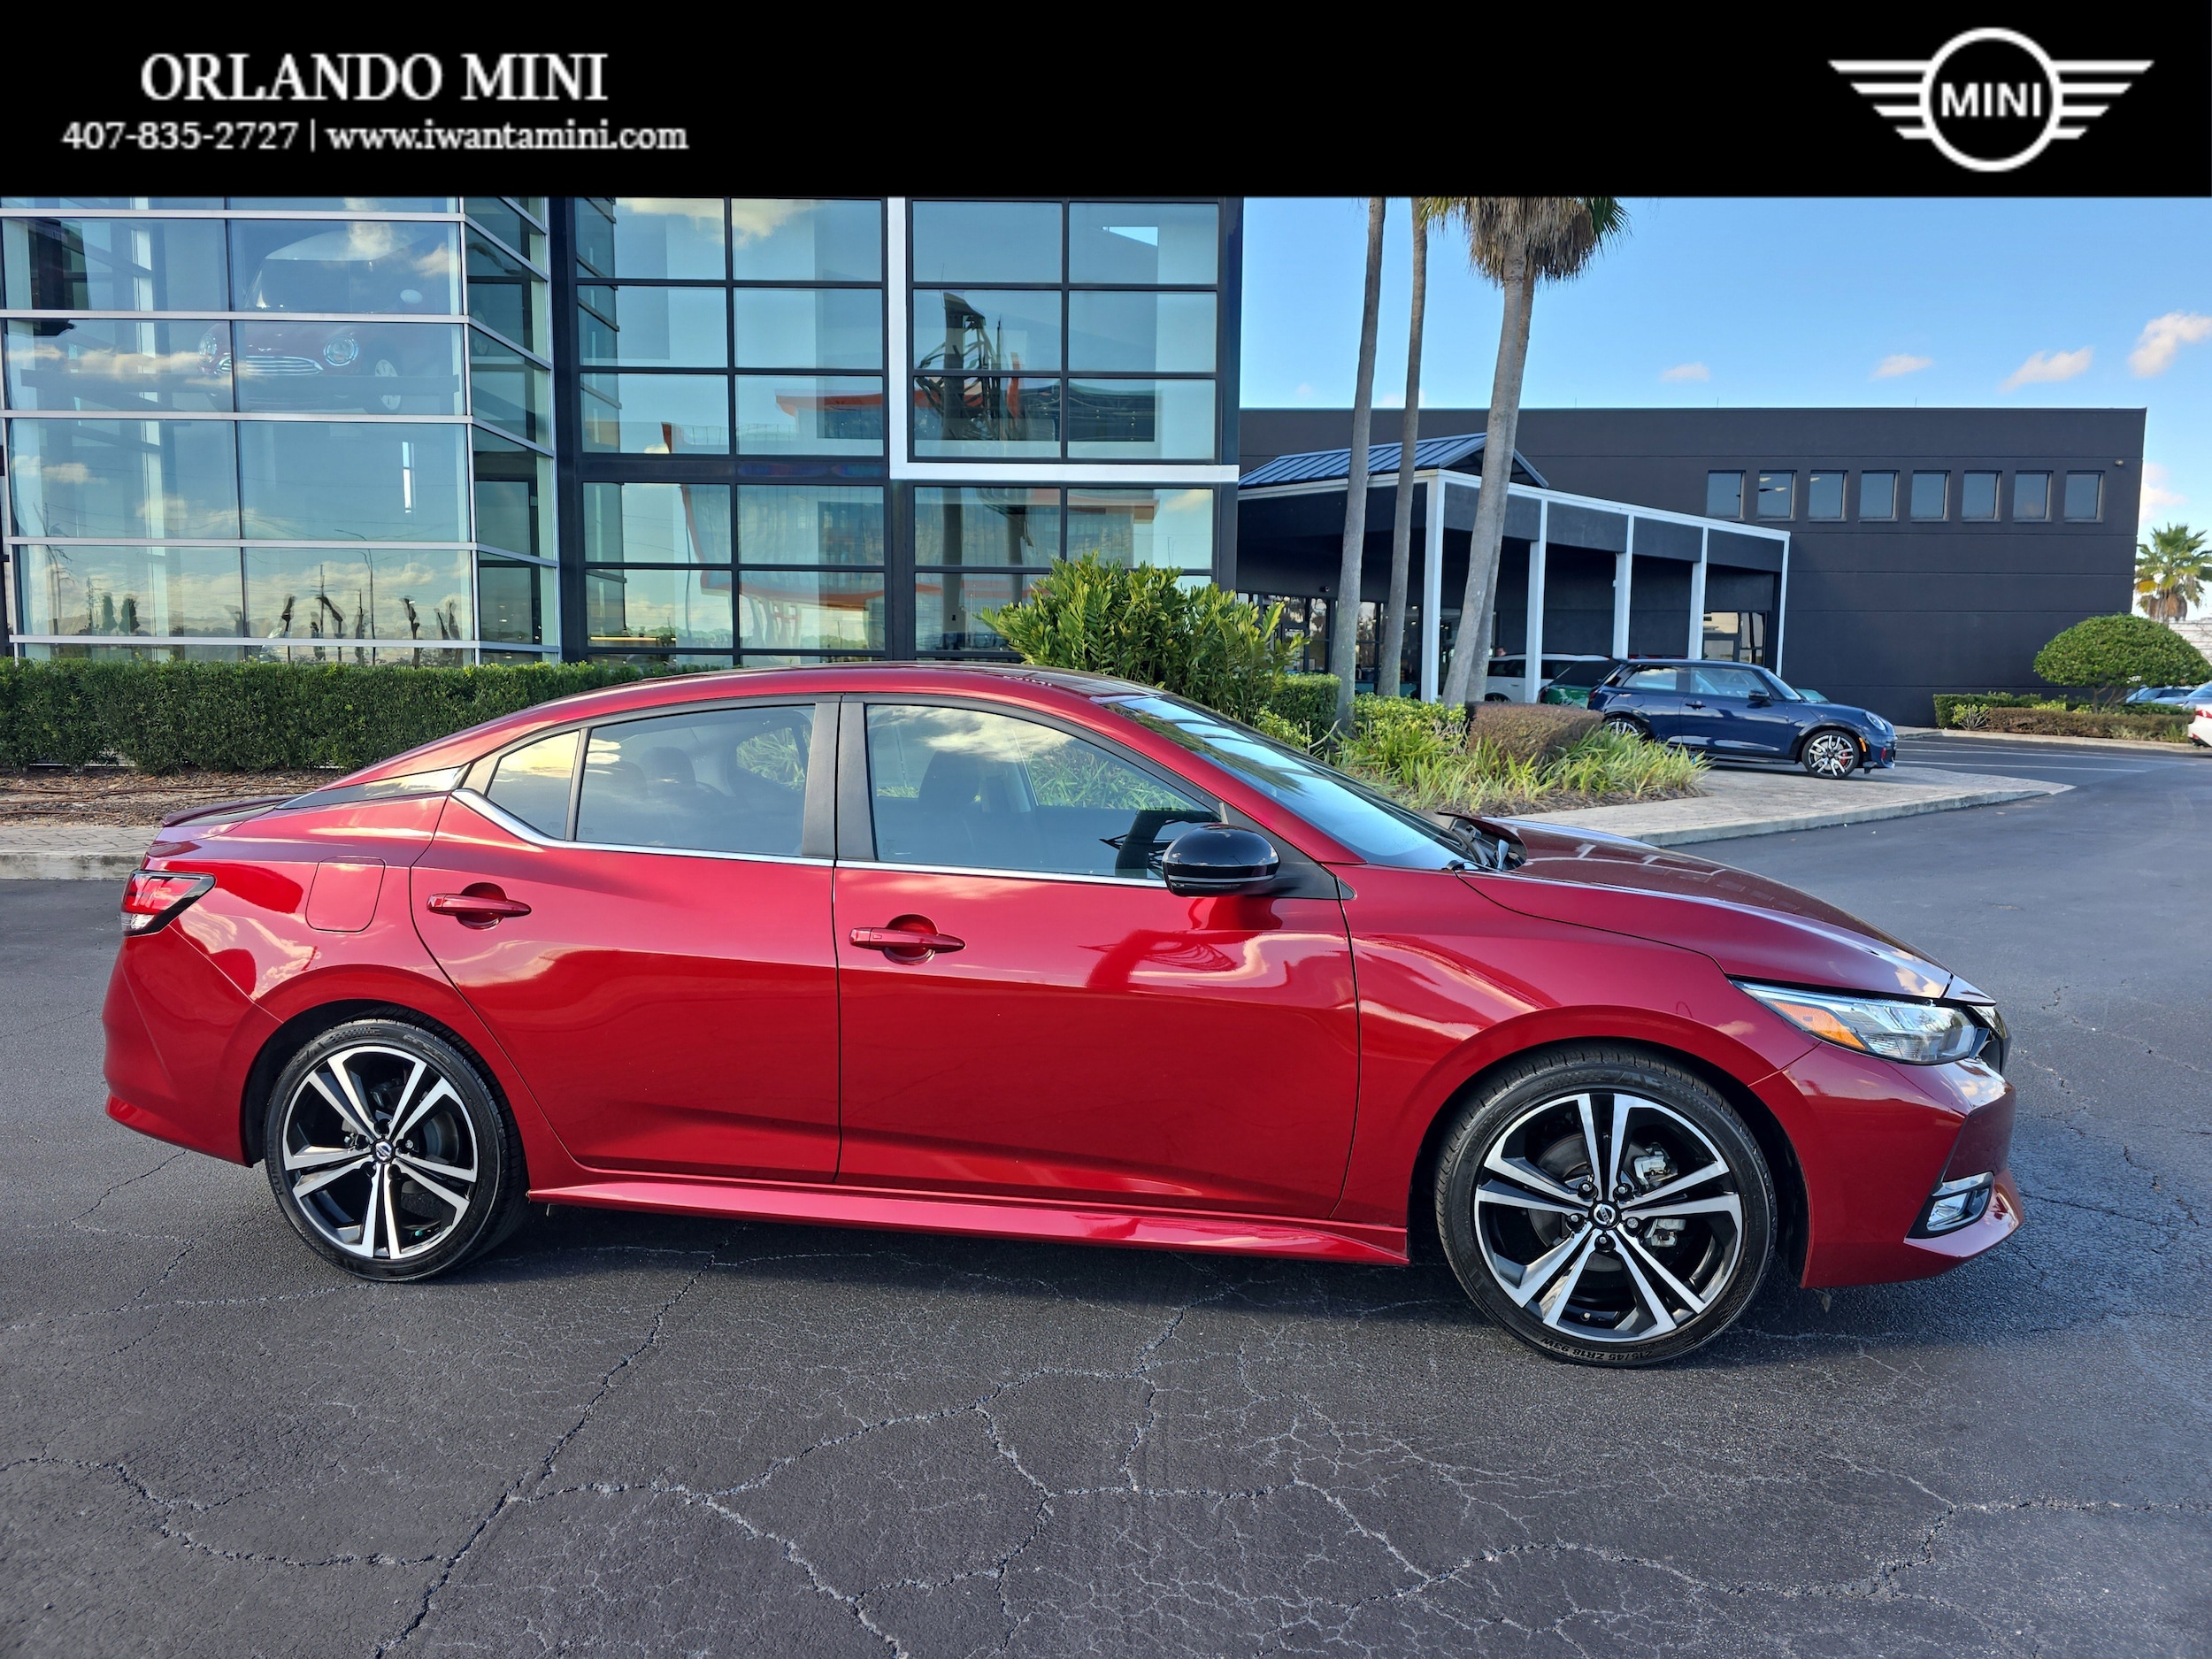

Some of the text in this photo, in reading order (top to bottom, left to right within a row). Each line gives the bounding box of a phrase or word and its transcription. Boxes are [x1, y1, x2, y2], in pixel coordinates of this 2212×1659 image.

[1540, 1337, 1653, 1362] 215/45 ZR18 93W
